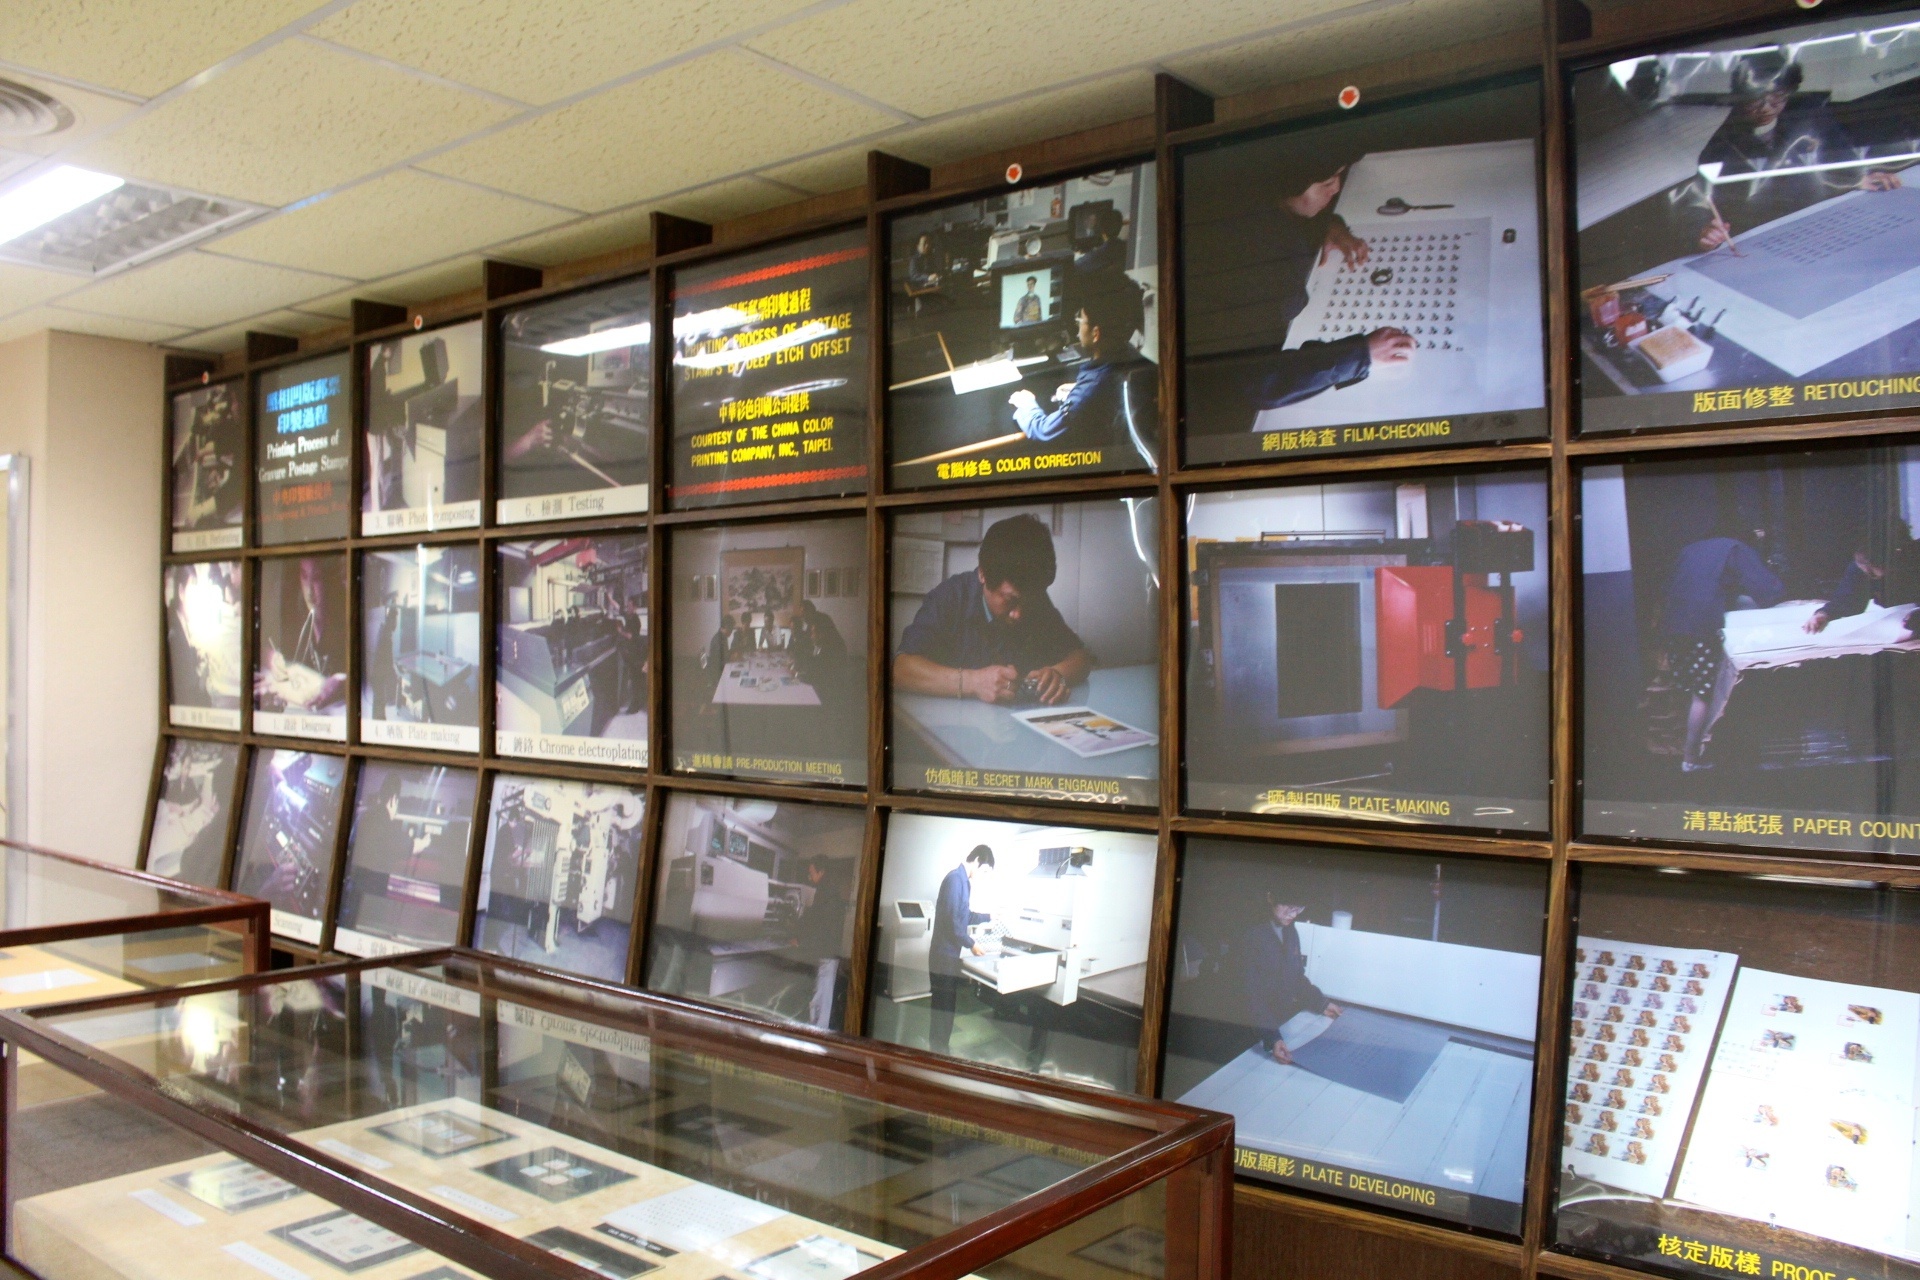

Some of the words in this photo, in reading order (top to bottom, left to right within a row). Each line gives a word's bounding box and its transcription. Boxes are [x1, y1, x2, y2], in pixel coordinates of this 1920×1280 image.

[776, 346, 804, 365] ETCH
[810, 337, 852, 359] OFFSET
[1692, 385, 1795, 413] 版面修整
[267, 440, 297, 460] Printing
[298, 435, 329, 454] Process
[331, 429, 340, 446] of
[691, 430, 732, 449] COURTESY
[736, 428, 748, 443] OF
[751, 425, 769, 440] THE
[771, 421, 800, 438] CHINA
[803, 416, 834, 434] COLOR
[1343, 420, 1450, 443] FILM-CHECKING
[691, 449, 729, 467] PRINTING
[732, 445, 776, 463] COMPANY,
[803, 437, 833, 454] TAIPEI.
[937, 459, 992, 480] 電腦修色
[996, 456, 1031, 473] COLOR
[1034, 450, 1102, 470] CORRECTION
[258, 466, 287, 483] Gravure
[288, 460, 319, 478] Postage
[320, 454, 350, 471] Stamps
[525, 503, 535, 517] 6.
[568, 493, 605, 511] Testing
[430, 728, 460, 744] making
[539, 738, 575, 756] Chrome
[578, 740, 648, 763] electroplating
[736, 757, 802, 772] PRE-PRODUCTION
[805, 762, 842, 775] MEETING
[983, 774, 1021, 788] SECRET
[1025, 776, 1054, 790] MARK
[1058, 777, 1120, 794] ENGRAVING
[1349, 796, 1450, 816] PLATE-MAKING
[1682, 810, 1784, 836] 清點紙張
[1793, 817, 1852, 836] PAPER
[1859, 820, 1920, 840] COUNT
[1302, 1164, 1343, 1186] PLATE
[1350, 1174, 1436, 1206] DEVELOPING
